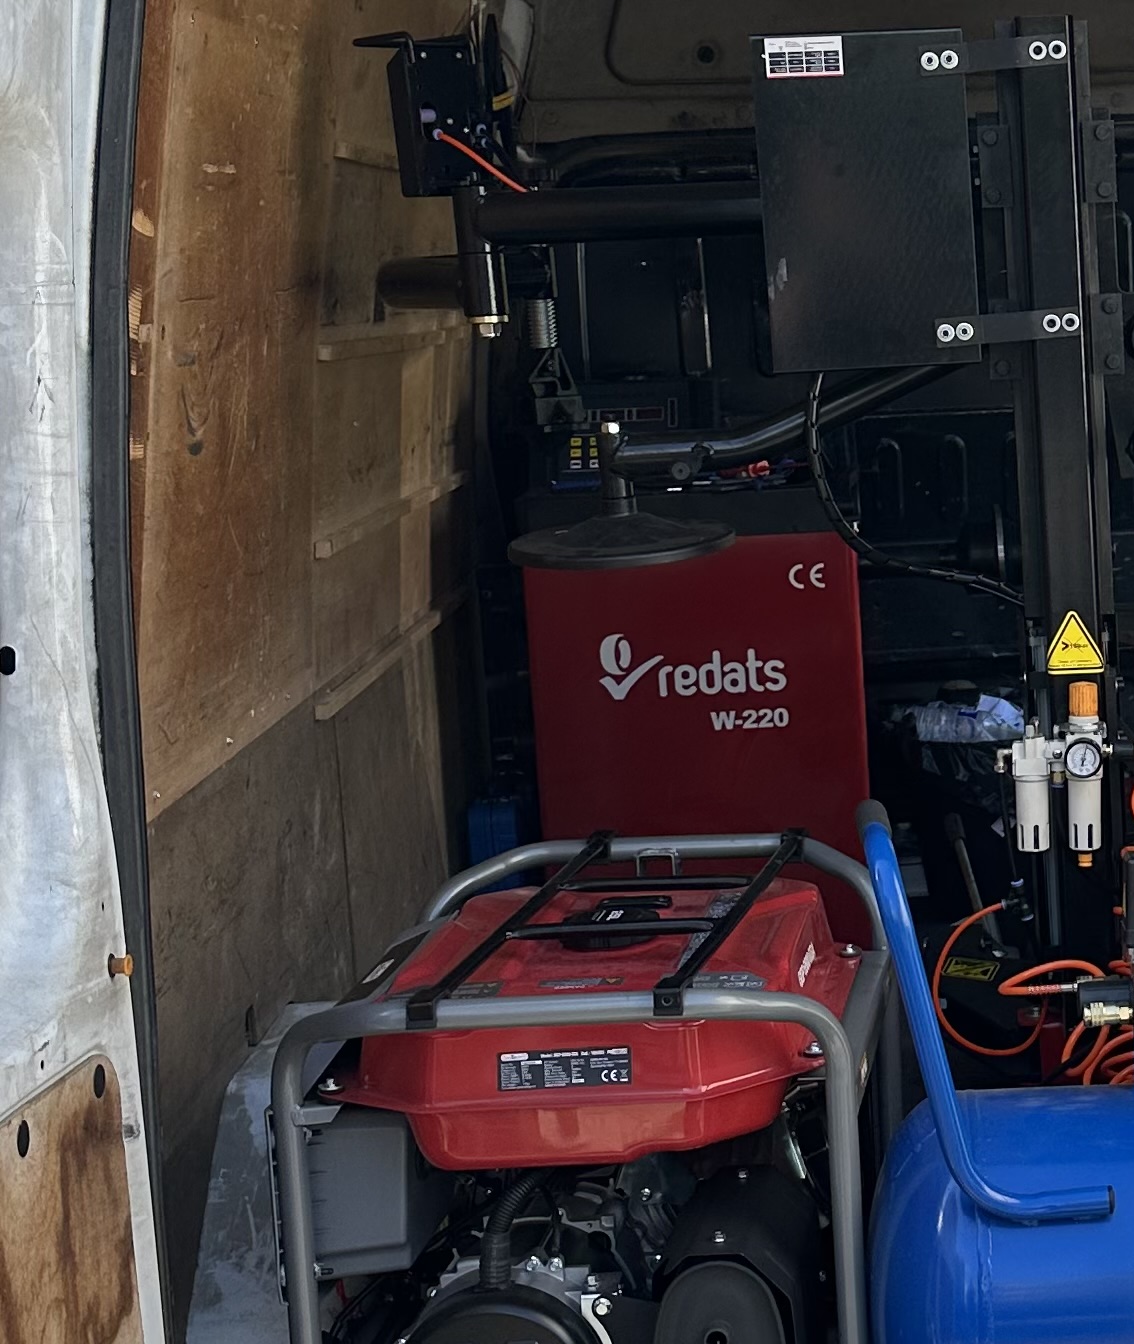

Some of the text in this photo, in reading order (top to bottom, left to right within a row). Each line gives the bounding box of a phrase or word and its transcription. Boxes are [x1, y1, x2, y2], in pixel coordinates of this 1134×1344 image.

[788, 562, 826, 589] CE
[658, 648, 788, 697] redats
[710, 707, 790, 731] W-220
